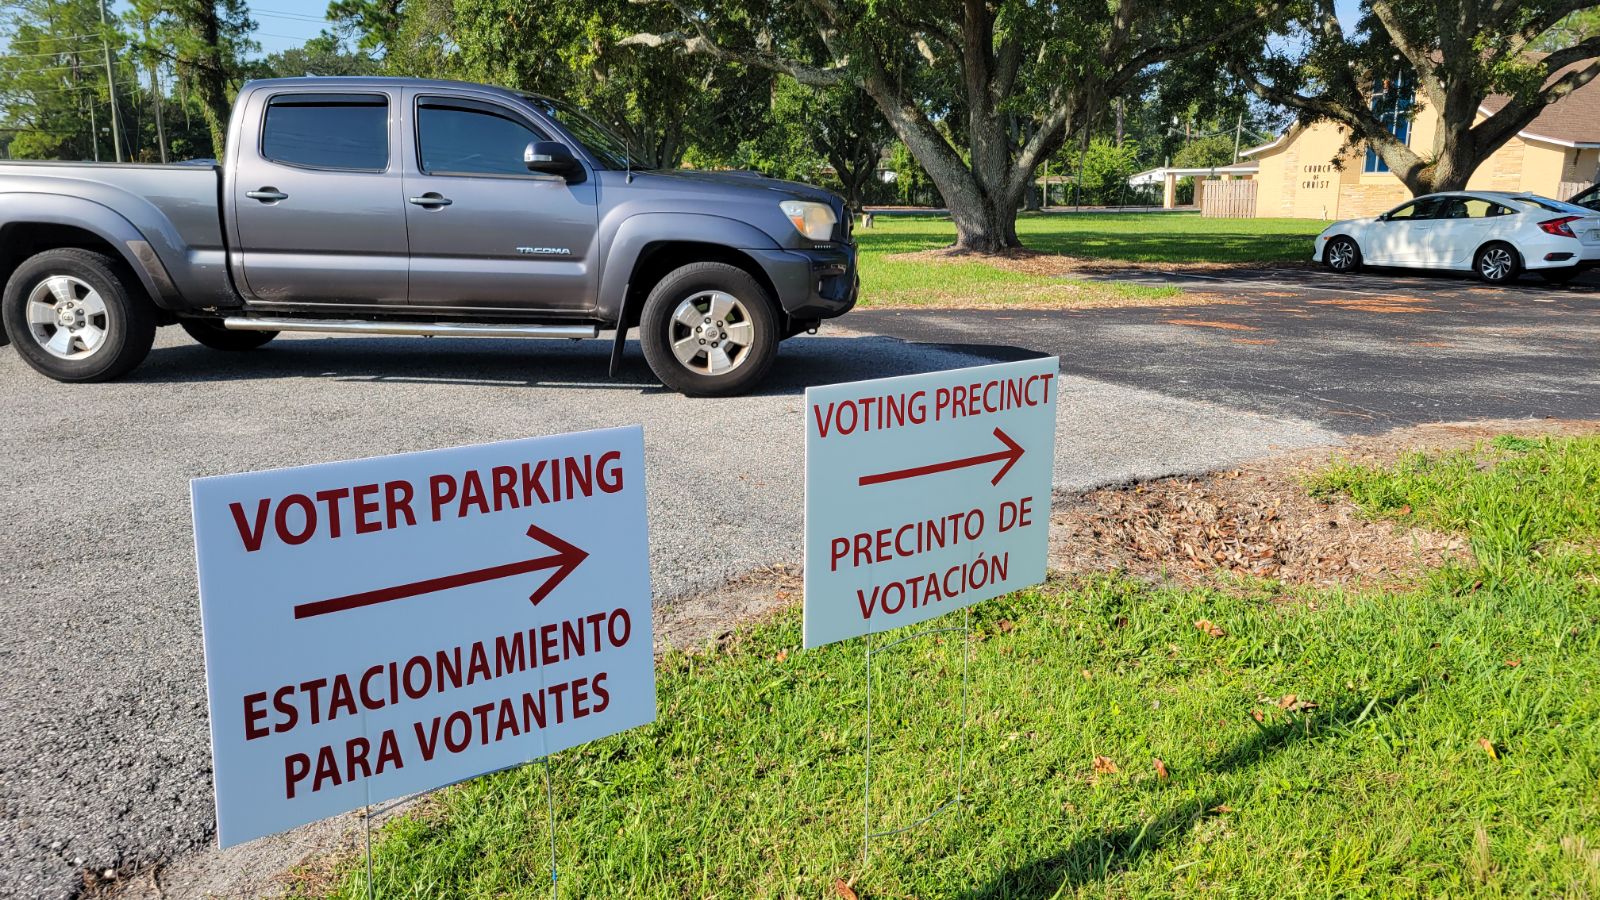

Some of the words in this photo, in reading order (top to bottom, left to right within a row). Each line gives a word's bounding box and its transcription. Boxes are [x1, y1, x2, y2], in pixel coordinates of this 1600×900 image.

[516, 247, 571, 255] TACOMA
[813, 390, 926, 438] VOTING
[935, 373, 1054, 421] PRECINCT
[229, 479, 416, 552] VOTER
[429, 450, 624, 522] PARKING
[830, 508, 985, 572] PRECINTO
[998, 496, 1033, 533] DE
[856, 552, 1009, 620] VOTACIÓN
[243, 607, 631, 741] ESTACIONAMIENTO
[284, 729, 403, 799] PARA
[413, 672, 610, 761] VOTANTES
